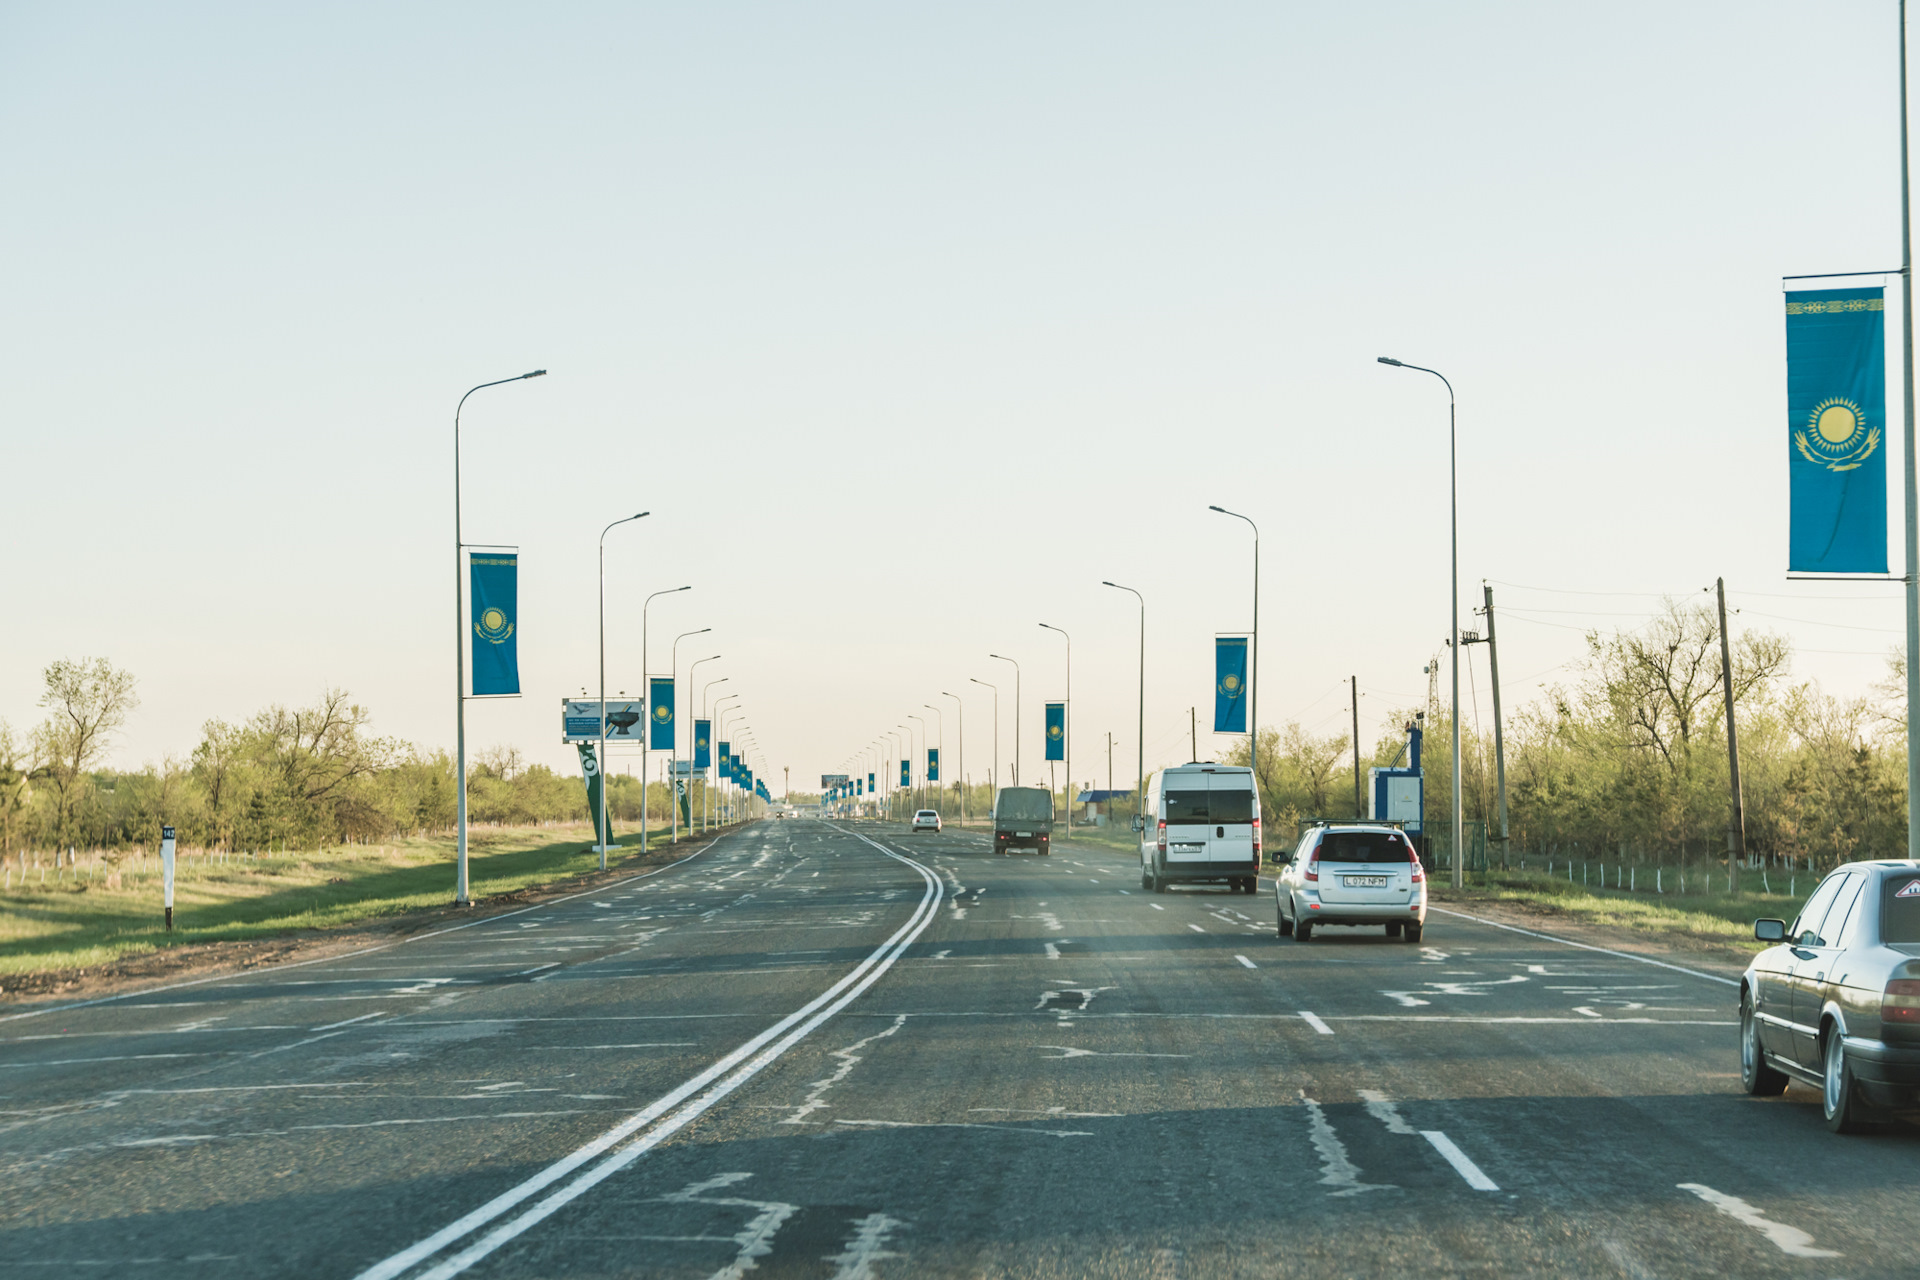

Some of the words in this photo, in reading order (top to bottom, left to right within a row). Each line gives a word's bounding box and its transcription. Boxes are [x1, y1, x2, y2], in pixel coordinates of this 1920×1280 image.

[164, 830, 174, 838] 142
[1346, 877, 1351, 885] L
[1352, 877, 1366, 885] 072
